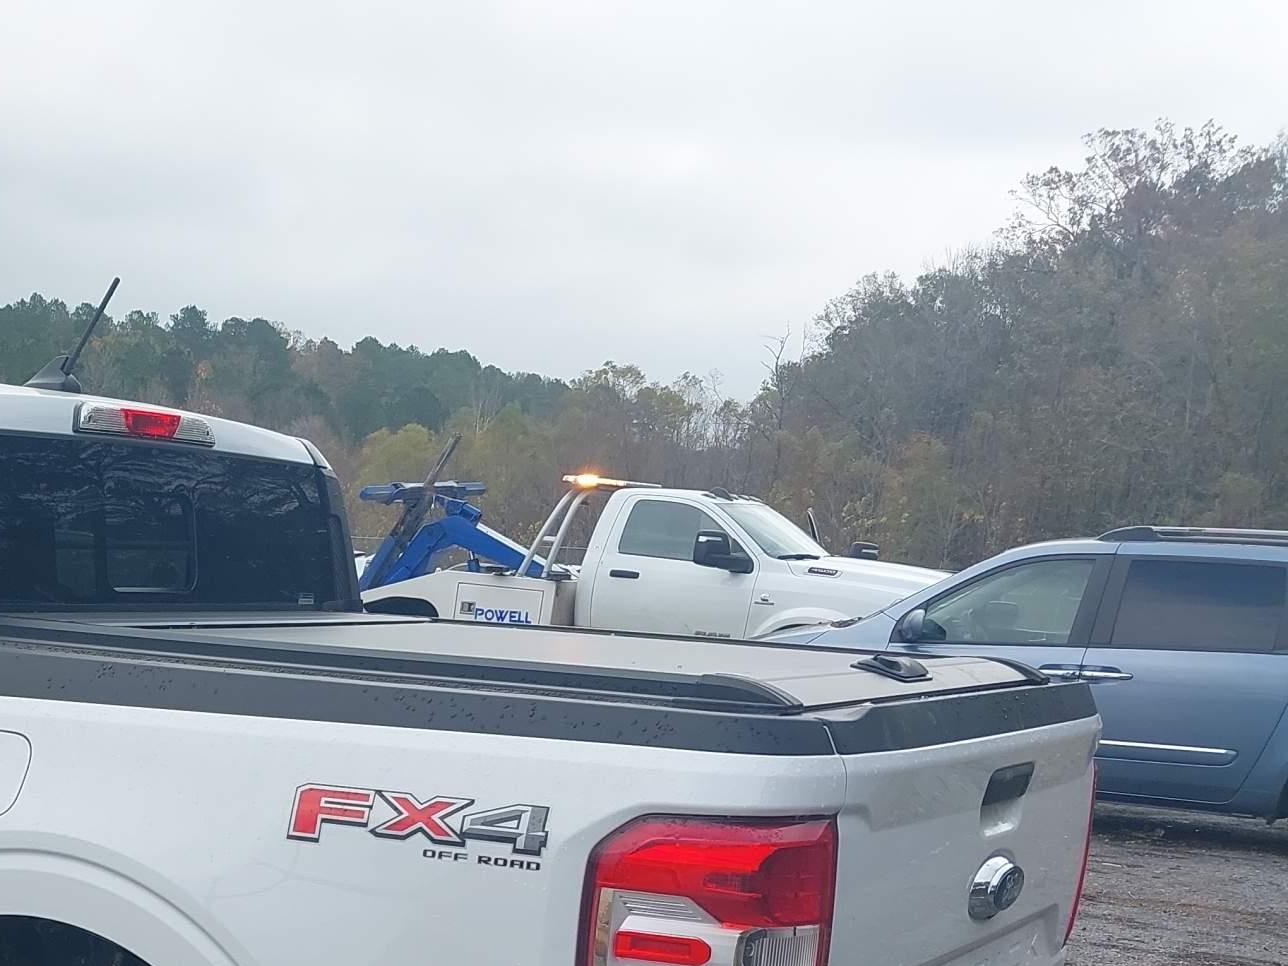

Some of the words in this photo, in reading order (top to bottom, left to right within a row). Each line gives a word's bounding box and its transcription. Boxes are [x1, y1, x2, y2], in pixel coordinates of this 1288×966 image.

[474, 607, 532, 624] POWELL
[286, 783, 551, 855] FX4
[422, 848, 469, 862] OFF
[477, 854, 542, 872] ROAD
